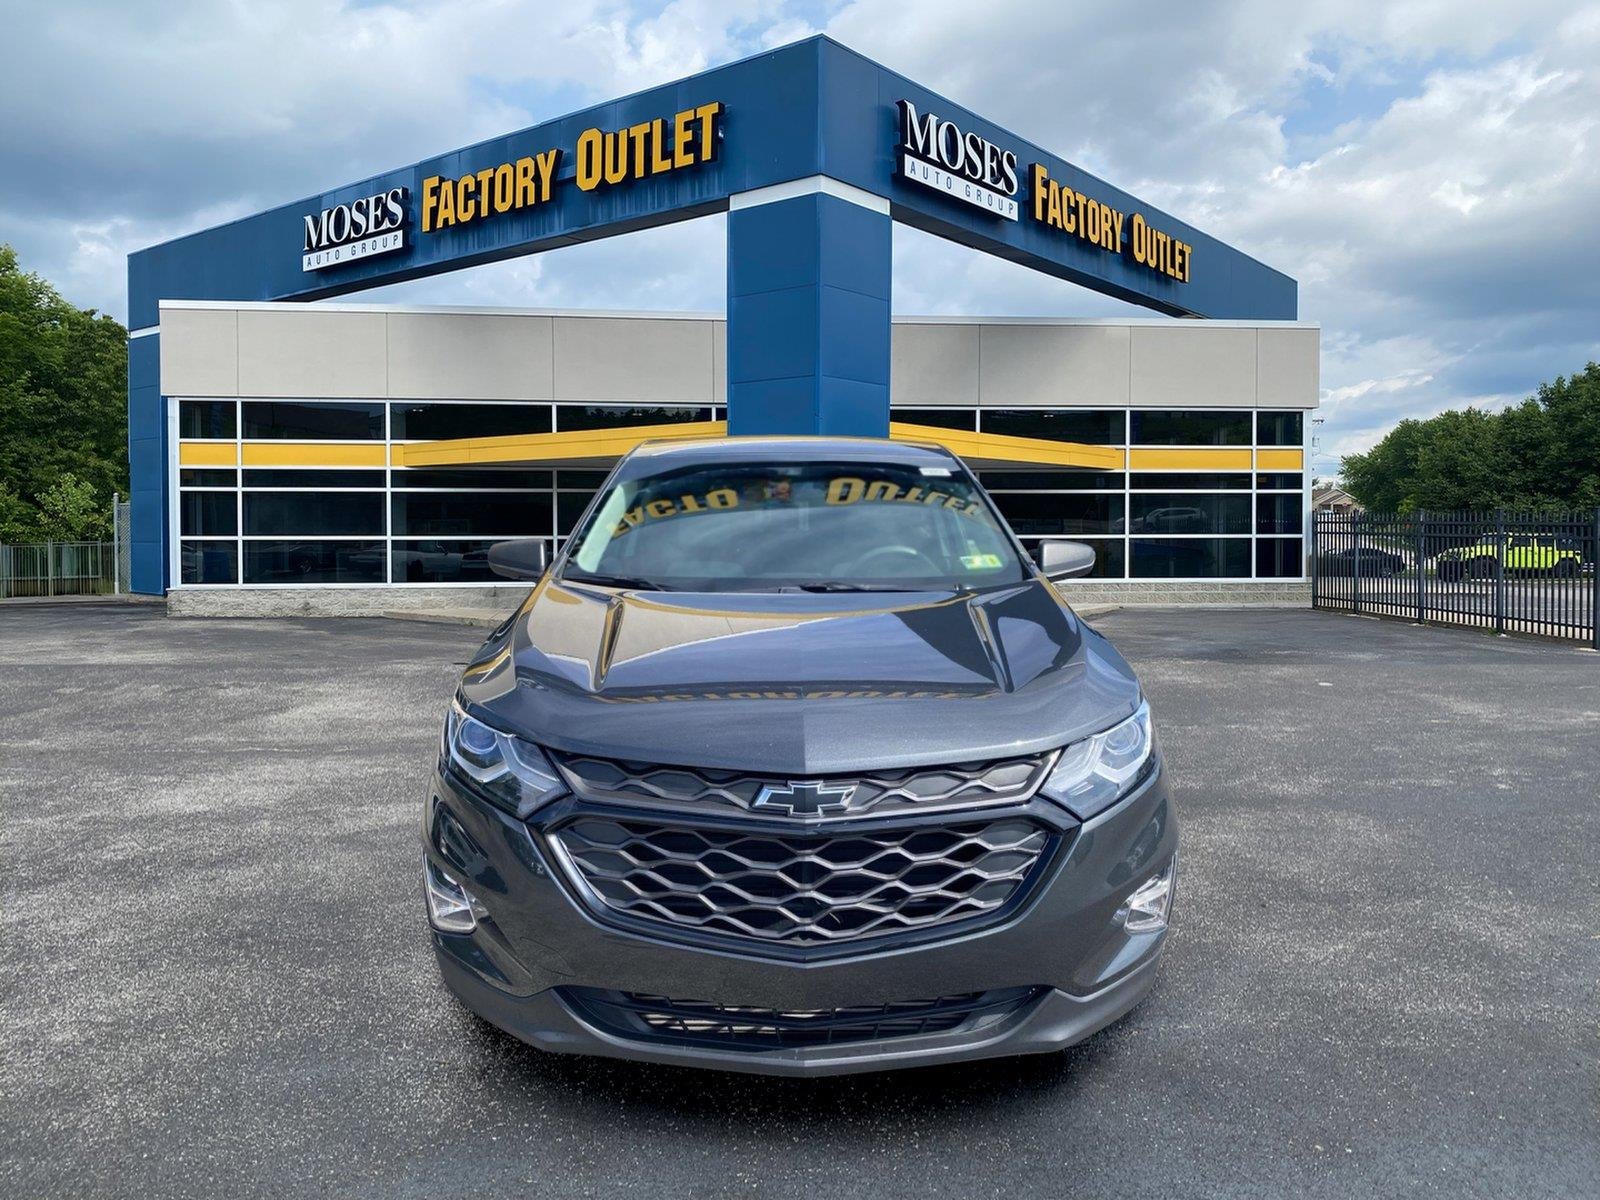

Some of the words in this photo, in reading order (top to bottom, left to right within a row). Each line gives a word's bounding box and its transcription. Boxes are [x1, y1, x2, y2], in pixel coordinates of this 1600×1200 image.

[422, 149, 559, 232] FACTORY
[576, 102, 720, 191] OUTLET
[904, 99, 1018, 195] MOSES
[303, 187, 403, 251] MOSES
[910, 161, 952, 190] AUTO
[965, 184, 1014, 214] GROUP
[1035, 163, 1123, 253] FACTORY
[1133, 213, 1192, 283] OUTLET
[307, 249, 340, 267] AUTO
[351, 234, 399, 255] GROUP
